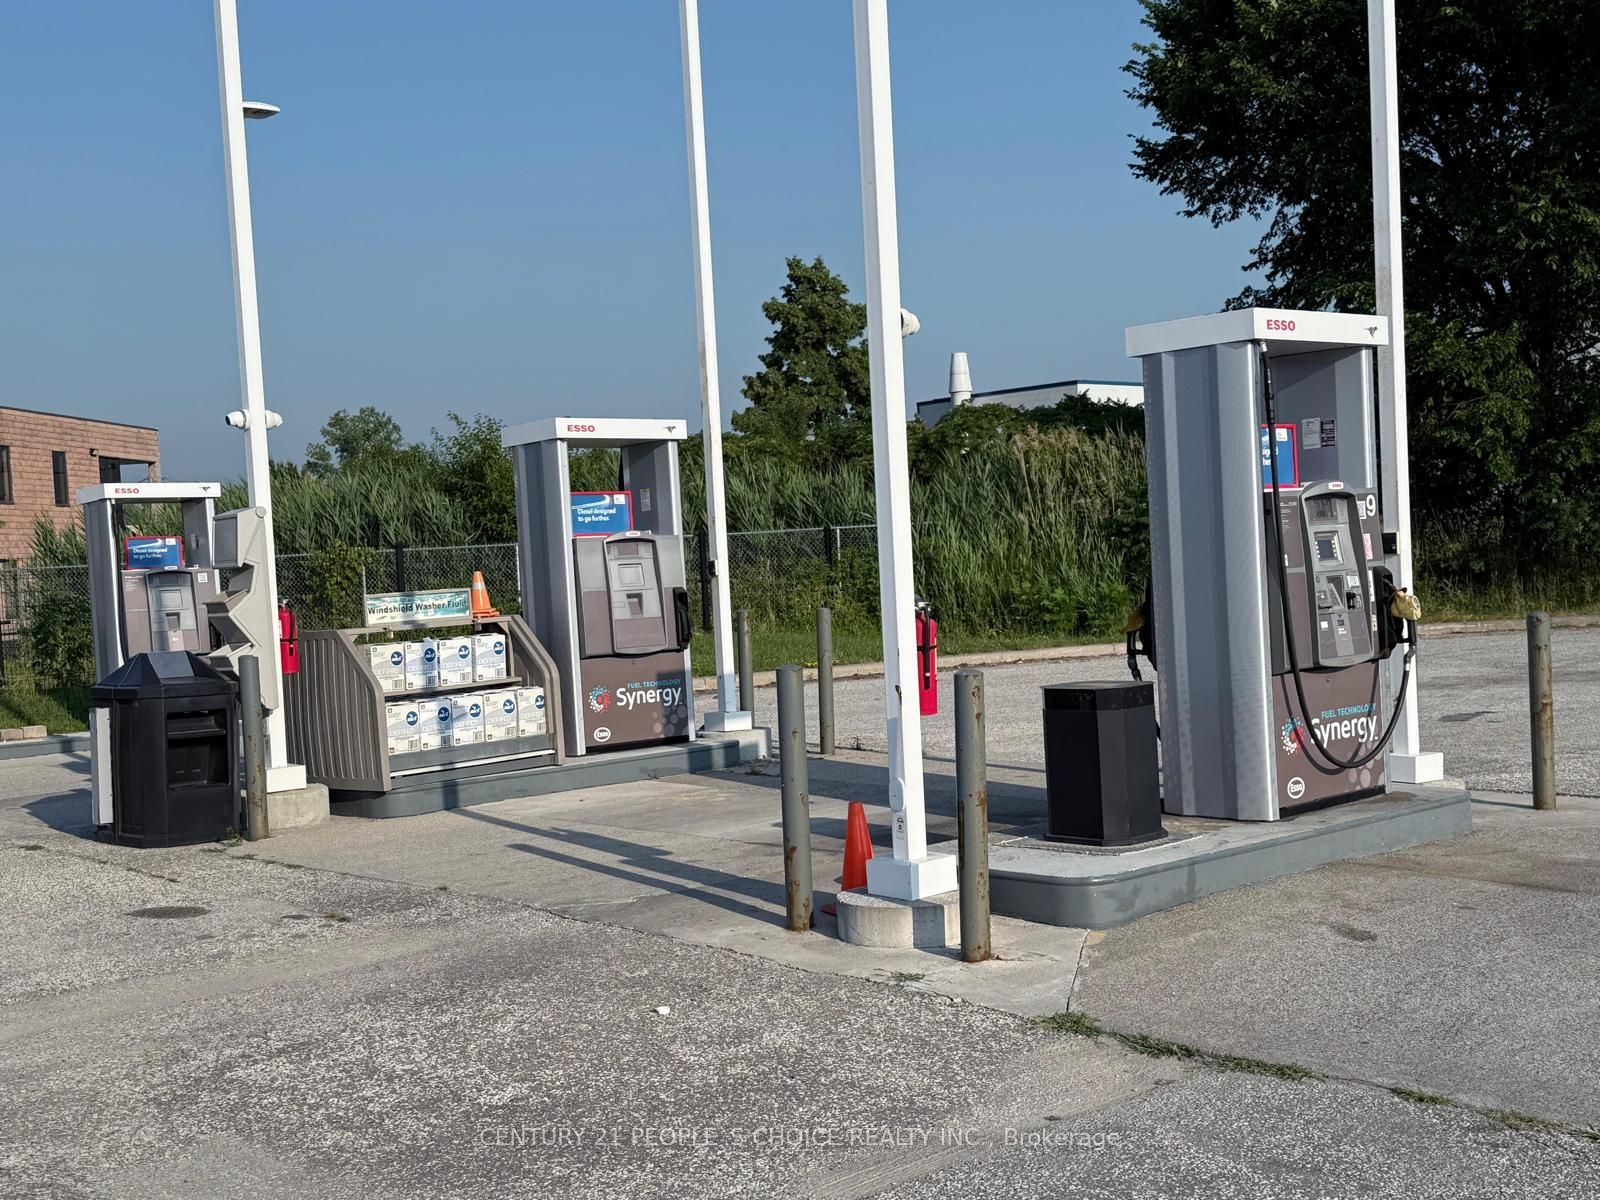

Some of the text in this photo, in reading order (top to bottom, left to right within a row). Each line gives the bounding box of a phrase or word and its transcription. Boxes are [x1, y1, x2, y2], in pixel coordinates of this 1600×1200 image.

[1266, 319, 1296, 332] ESSO
[567, 424, 595, 433] ESSO
[1366, 494, 1376, 517] 9
[368, 599, 467, 615] Windshield Washer Fluid
[643, 678, 681, 688] TECHNOLOGY
[616, 687, 682, 710] Synergy
[1321, 702, 1376, 719] FUEL TECHNOLOGY
[1310, 715, 1377, 749] Synergy
